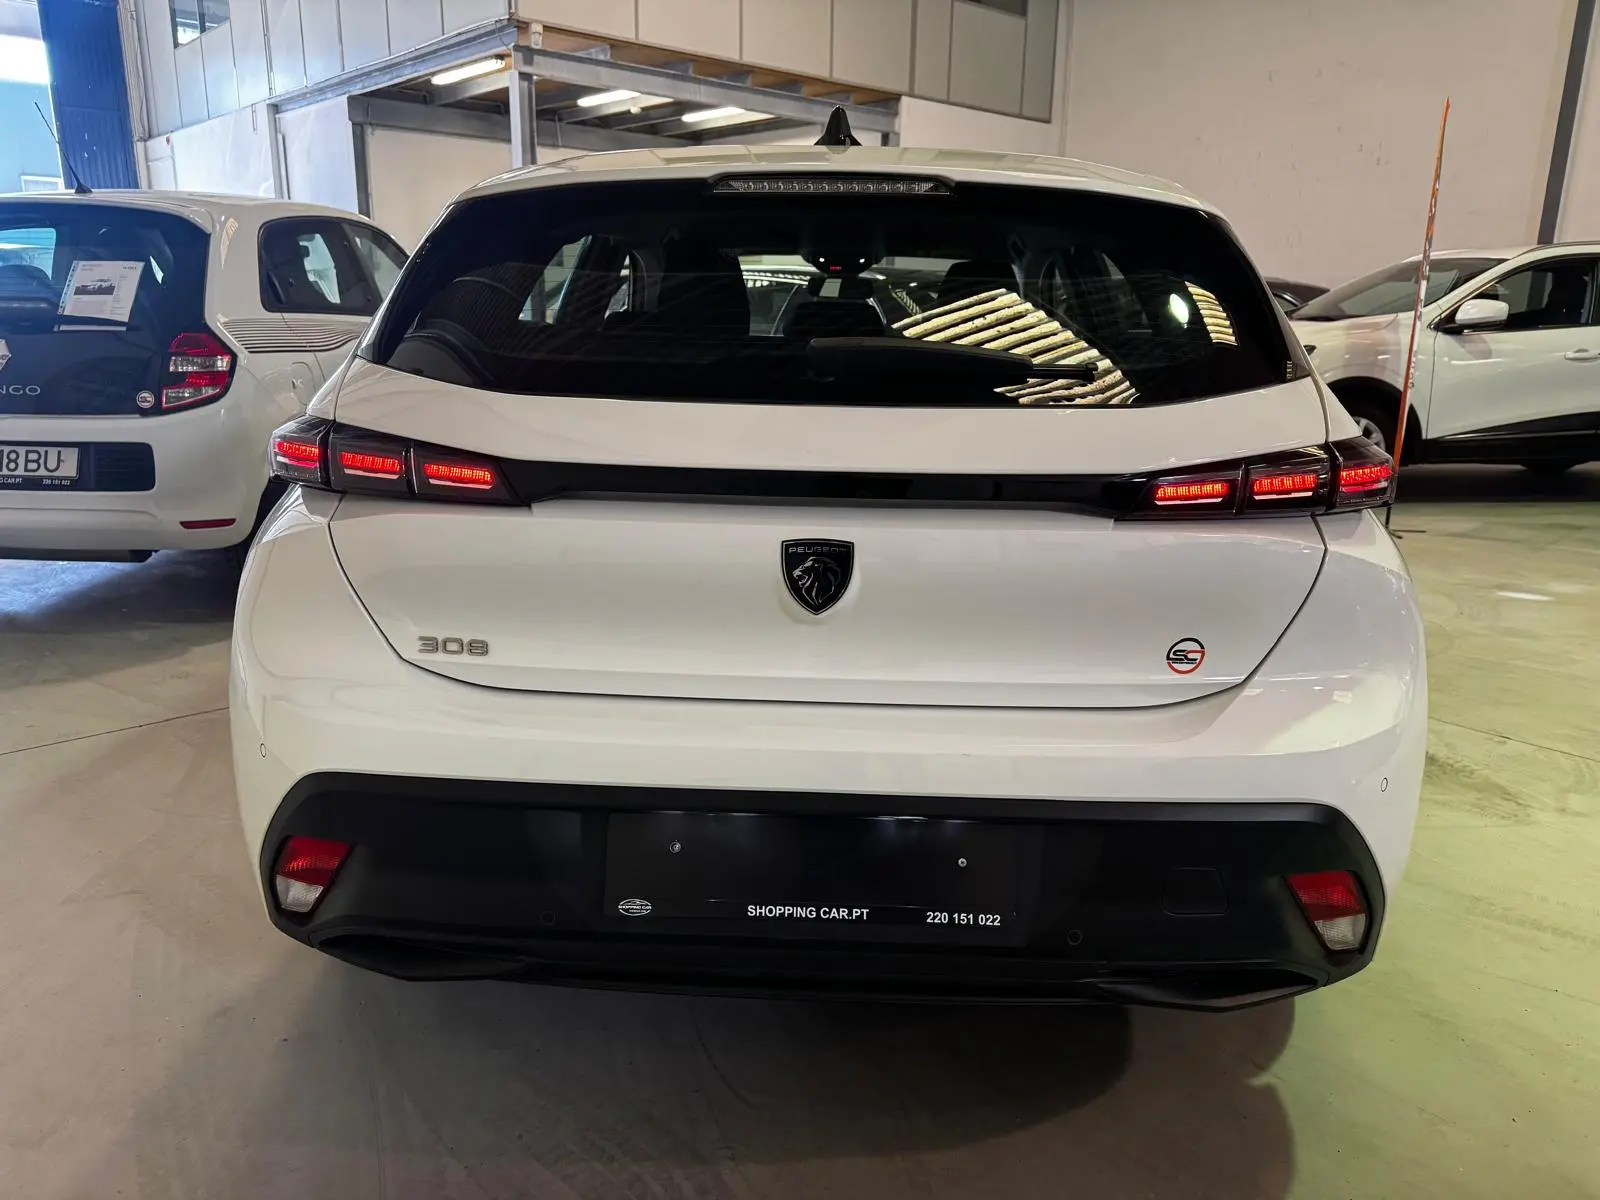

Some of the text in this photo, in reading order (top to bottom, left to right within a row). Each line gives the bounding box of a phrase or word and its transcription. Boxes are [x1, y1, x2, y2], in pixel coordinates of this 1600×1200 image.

[24, 449, 62, 473] BU
[788, 546, 847, 554] PEUGEOT
[418, 635, 489, 657] 308
[747, 904, 870, 921] SHOPPING CAR.PT
[926, 911, 1001, 926] 220 151 022
